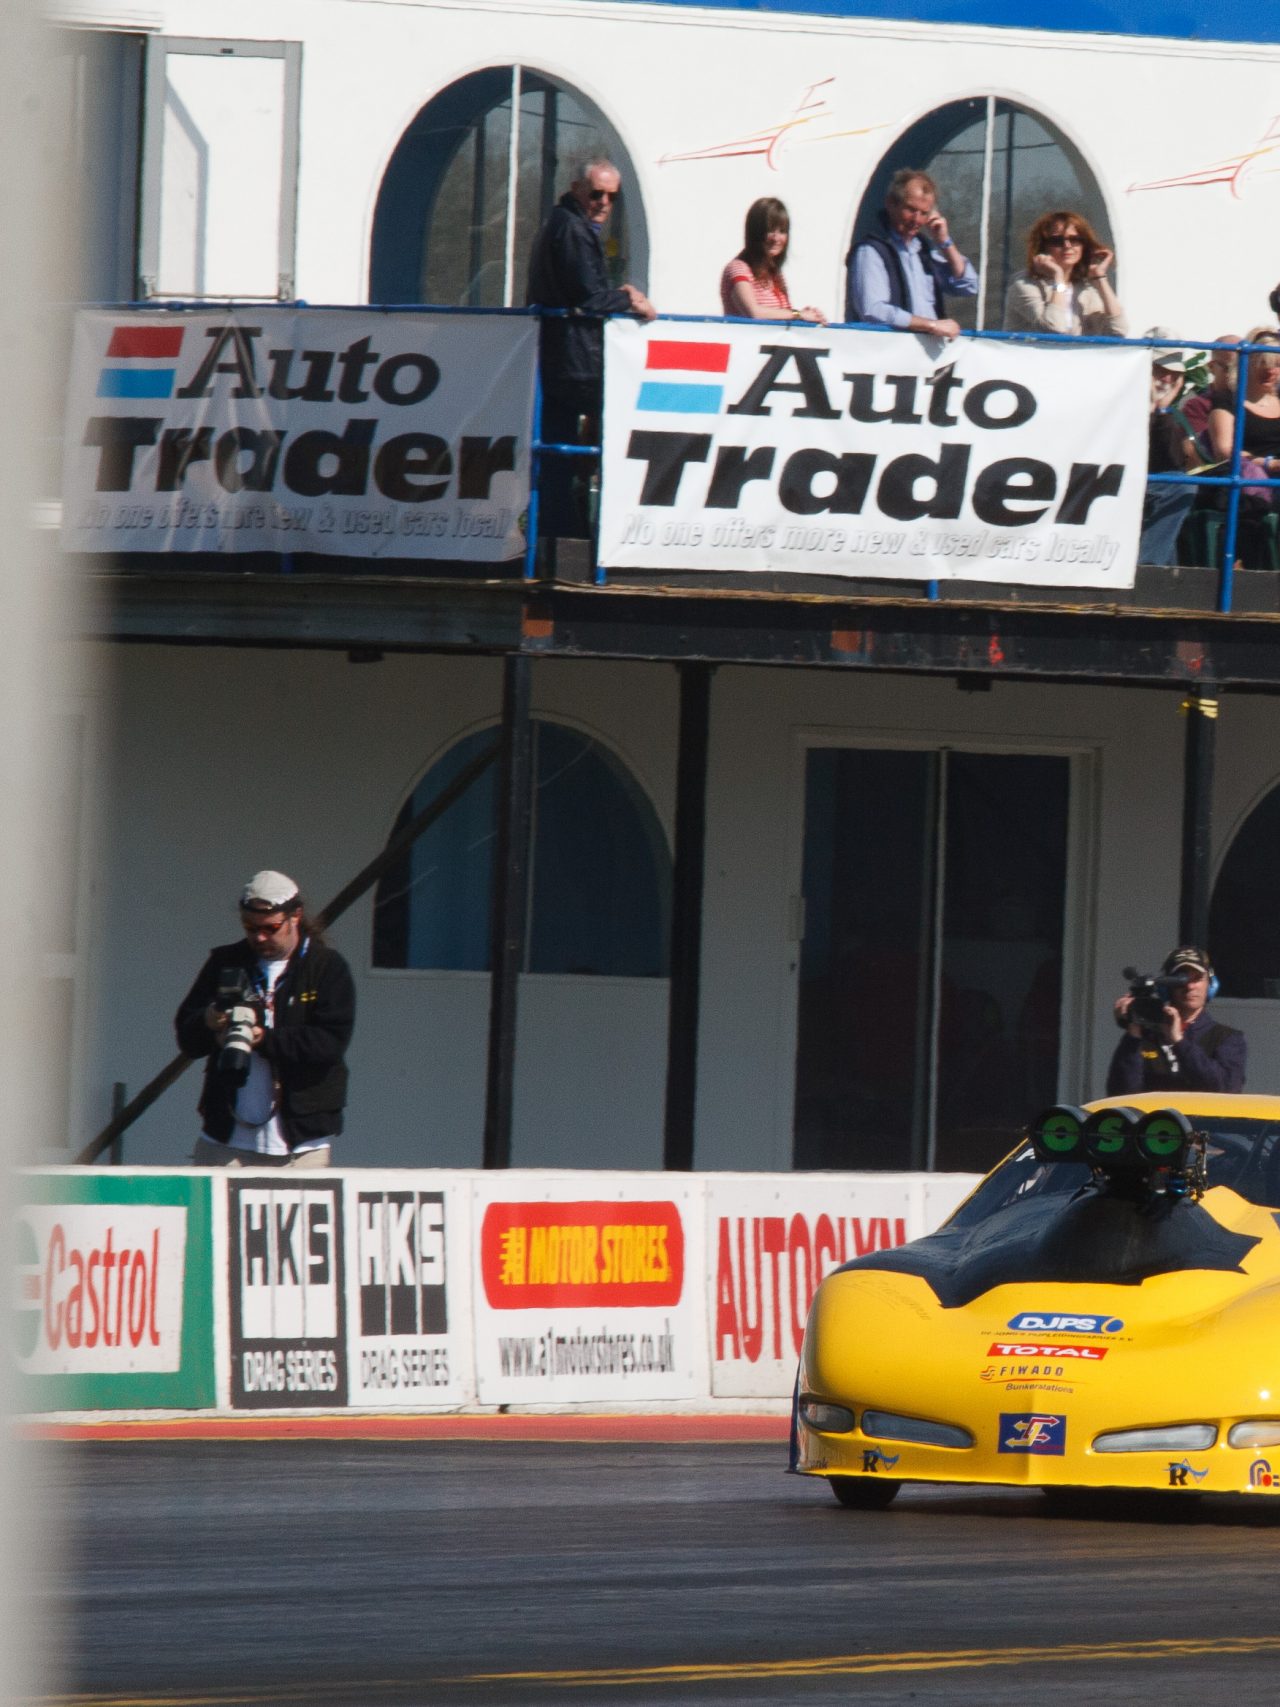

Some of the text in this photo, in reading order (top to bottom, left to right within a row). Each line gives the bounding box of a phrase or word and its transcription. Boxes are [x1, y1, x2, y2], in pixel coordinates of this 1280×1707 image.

[176, 325, 441, 406] Auto
[726, 344, 1037, 430] Auto
[82, 416, 517, 503] Trader
[626, 430, 1126, 527] Trader
[620, 512, 1120, 571] No one offers more new & used cars locally
[245, 1202, 330, 1287] HKS
[360, 1201, 445, 1286] HKS
[528, 1225, 599, 1285] MOTOR
[600, 1224, 672, 1285] STORES
[45, 1223, 160, 1352] Castrol
[996, 1343, 1100, 1359] TOTAL
[1018, 1316, 1097, 1331] DJPS
[243, 1349, 338, 1392] DRAG SERIES
[361, 1347, 449, 1389] DRAG SERIES
[1000, 1365, 1064, 1377] FIWADO
